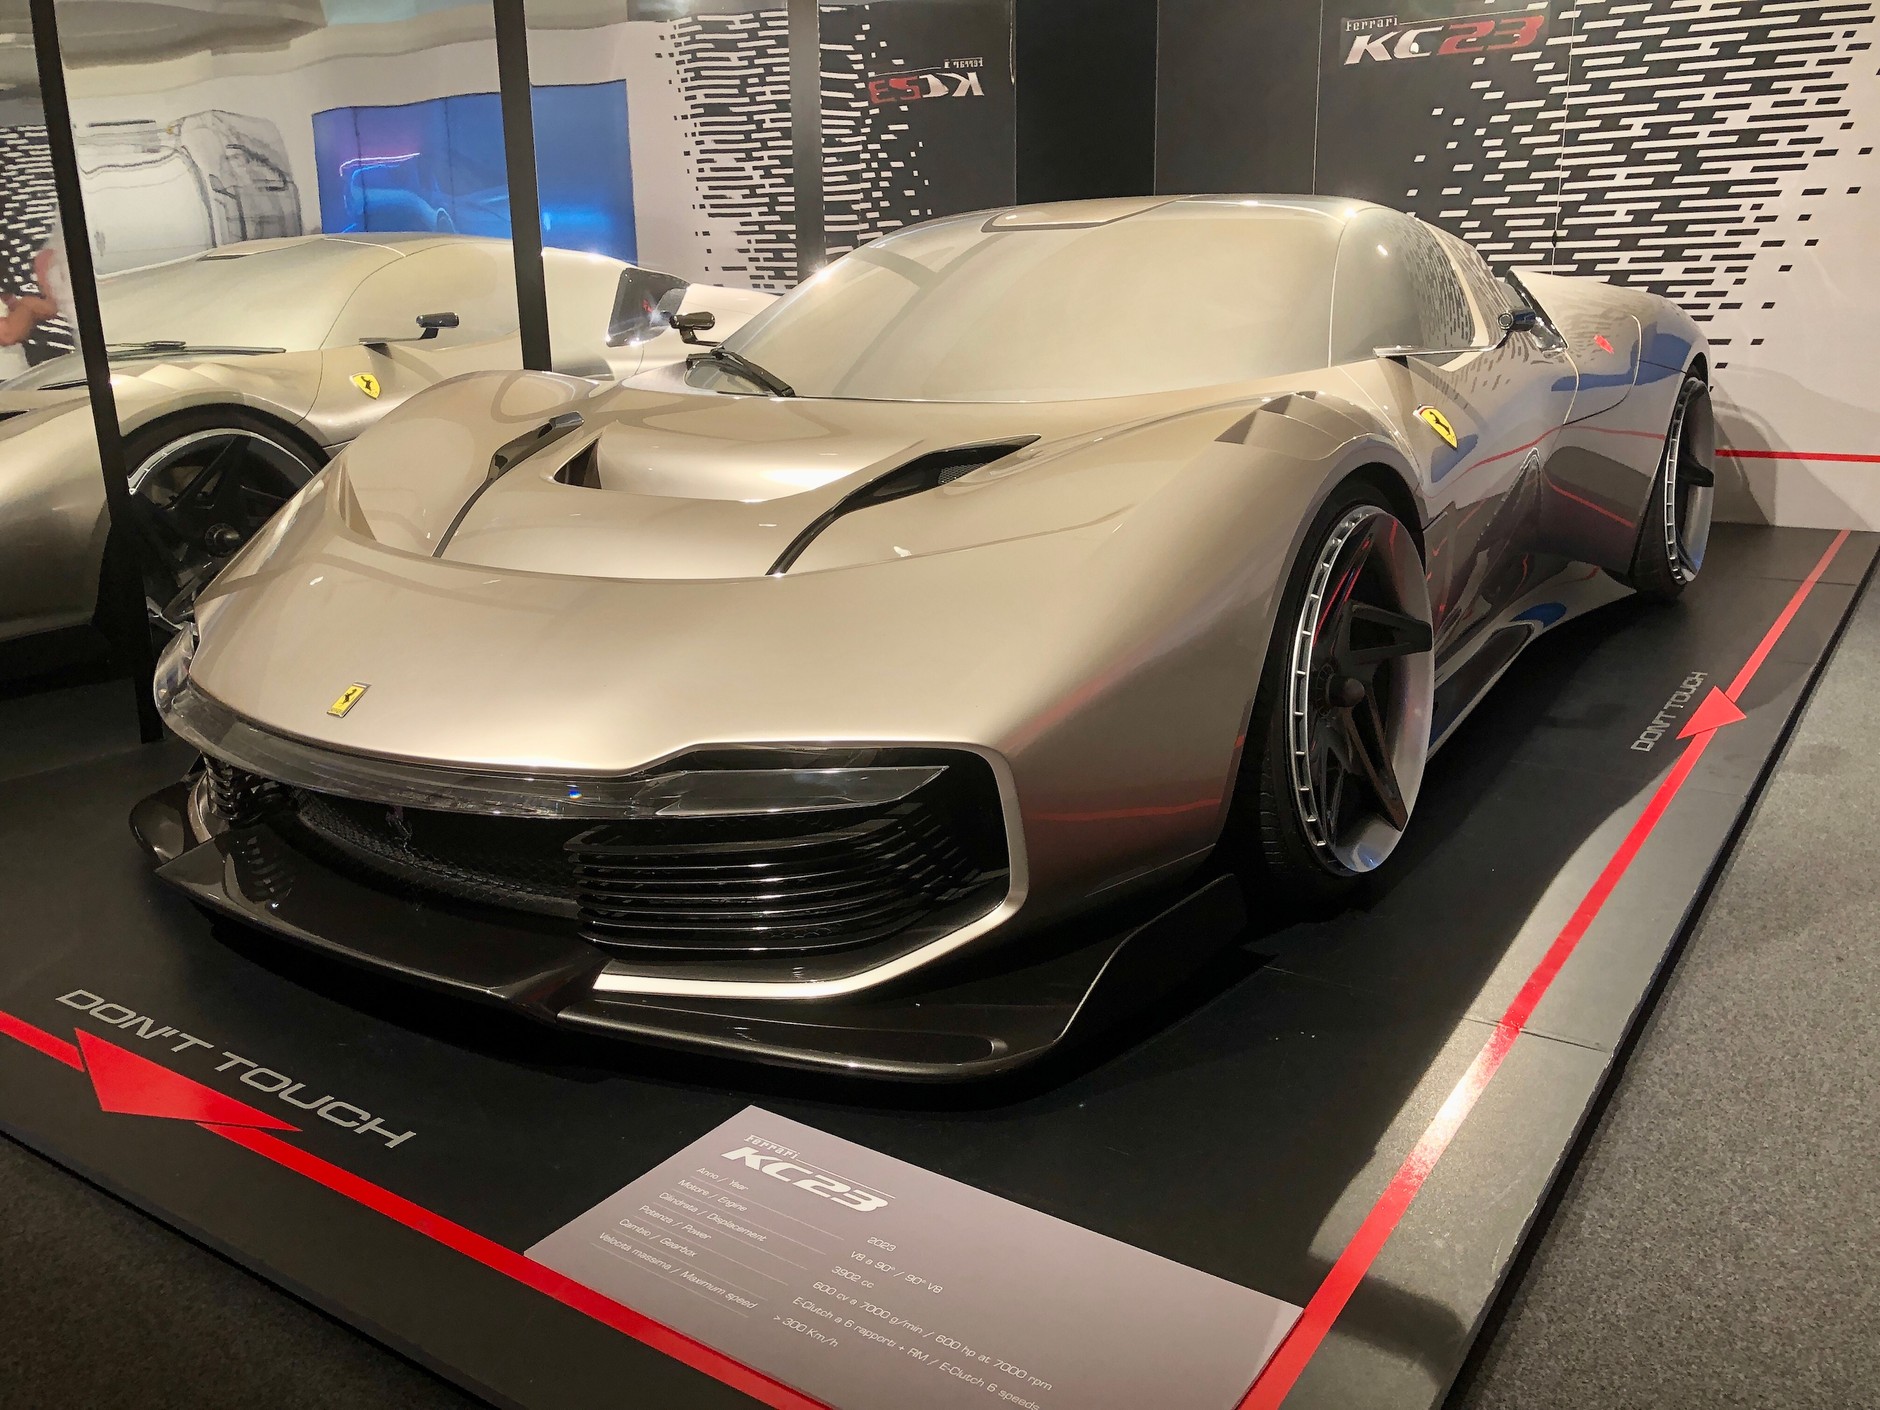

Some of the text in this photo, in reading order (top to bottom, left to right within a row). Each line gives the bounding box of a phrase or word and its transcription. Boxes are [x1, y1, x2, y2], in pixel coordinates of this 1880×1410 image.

[1344, 15, 1544, 65] KC23
[1345, 16, 1398, 31] Ferrari
[1663, 671, 1708, 710] TOUCH
[55, 989, 416, 1149] DON'T TOUCH
[744, 1134, 801, 1160] Ferrari
[677, 1179, 710, 1197] Motore
[717, 1196, 748, 1212] Engine
[696, 1167, 719, 1180] Anno
[728, 1179, 749, 1191] Year
[720, 1146, 889, 1212] KC23
[638, 1204, 674, 1225] Potenza
[681, 1224, 712, 1240] Power
[659, 1192, 699, 1213] Cilindrata
[706, 1212, 767, 1242] Displacement
[619, 1218, 652, 1237] Cambio
[659, 1237, 698, 1258] Gearbox
[867, 1236, 897, 1252] 2023
[631, 1249, 673, 1270] massima
[679, 1270, 726, 1295] Maximum
[725, 1291, 758, 1309] speed
[831, 1265, 875, 1289] 3902 cc
[850, 1250, 866, 1262] V8
[874, 1261, 896, 1272] 90°
[904, 1274, 927, 1285] 90°
[927, 1282, 943, 1294] V8
[782, 1317, 808, 1333] 300
[806, 1328, 839, 1348] Km/h
[812, 1281, 837, 1296] 600
[836, 1292, 850, 1301] cv
[860, 1301, 891, 1319] 7000
[888, 1316, 923, 1334] g/min
[935, 1334, 962, 1350] 600
[961, 1345, 977, 1357] hp
[977, 1354, 992, 1364] at
[993, 1359, 1028, 1379] 7000
[1027, 1375, 1053, 1392] rpm
[792, 1296, 834, 1319] E-Clutch
[833, 1316, 843, 1324] a
[843, 1319, 855, 1328] 6
[853, 1324, 897, 1348] rapporti
[907, 1347, 930, 1362] RM
[938, 1361, 985, 1388] E-Clutch
[986, 1383, 998, 1393] 6
[997, 1389, 1041, 1410] speeds
